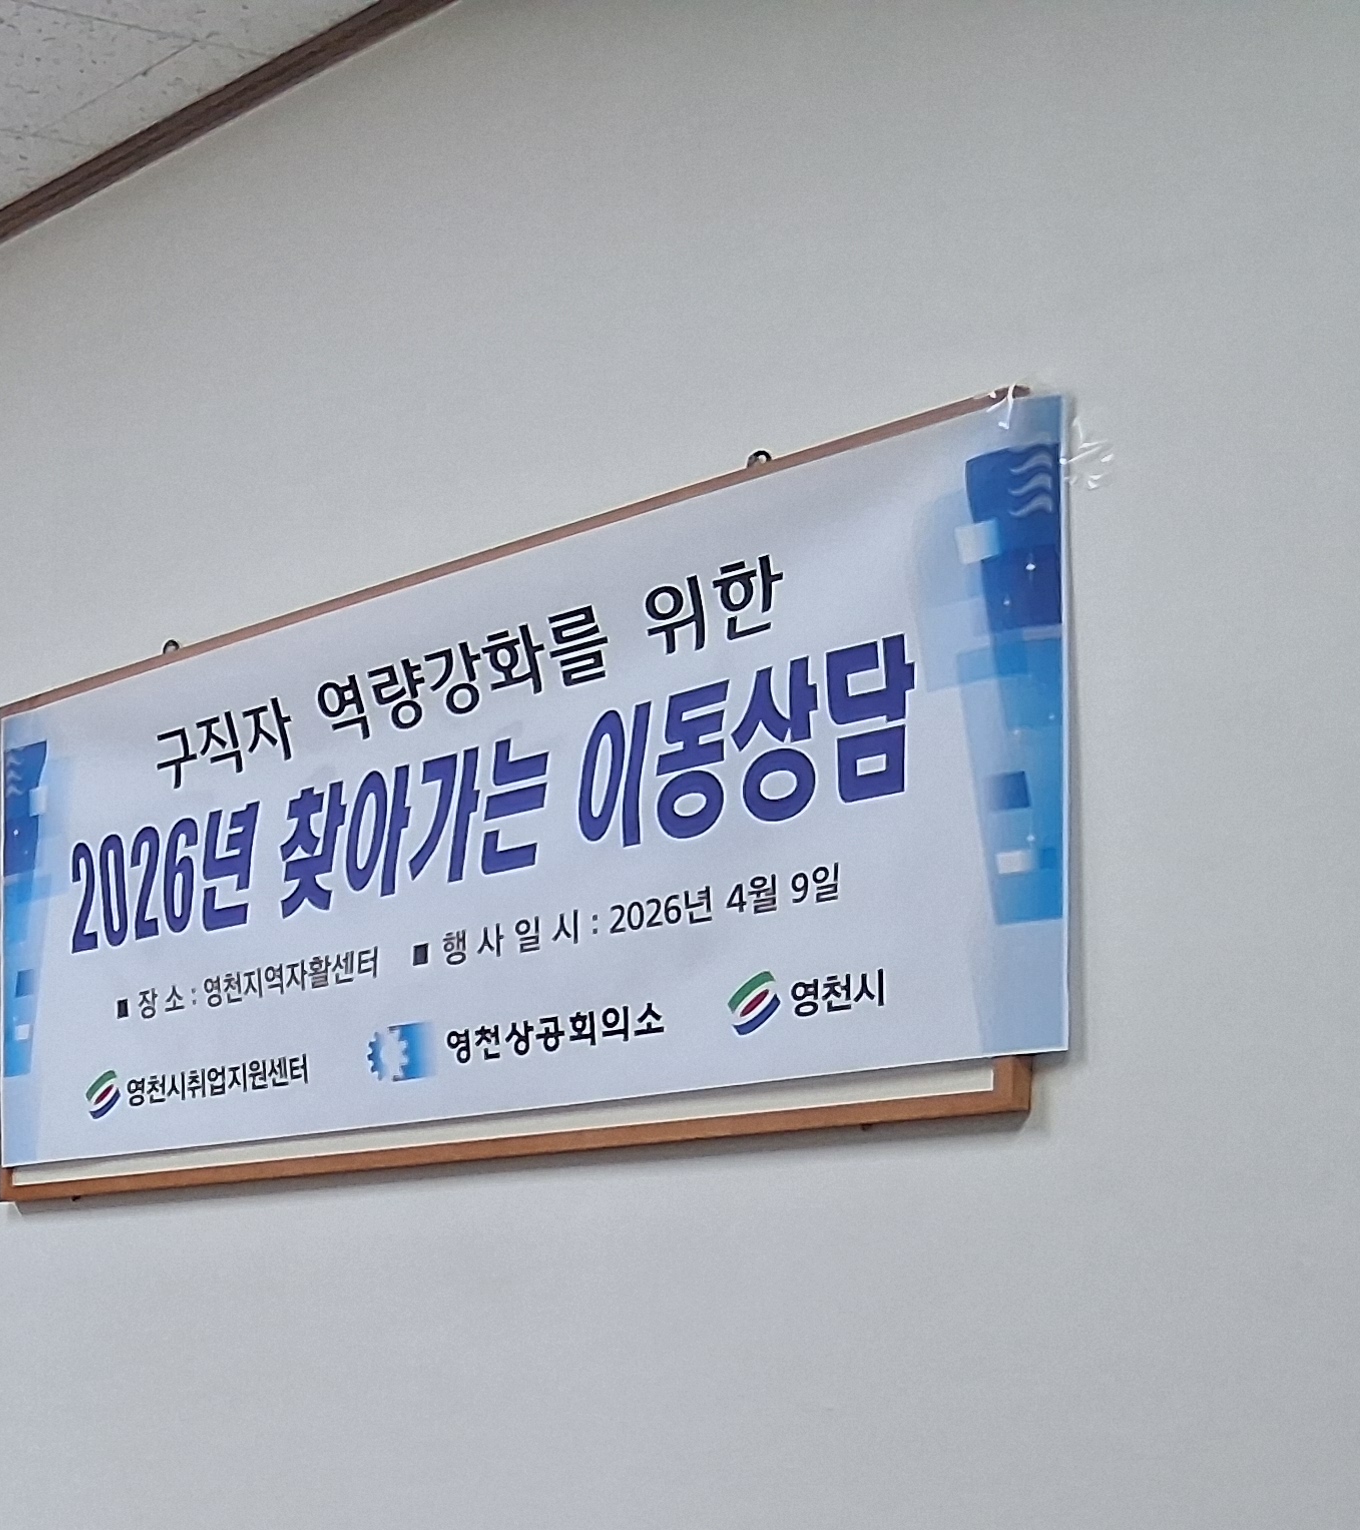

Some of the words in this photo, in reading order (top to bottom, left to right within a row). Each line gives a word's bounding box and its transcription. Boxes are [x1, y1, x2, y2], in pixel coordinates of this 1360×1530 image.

[154, 697, 293, 789] 구직자
[316, 605, 609, 740] 역량강화를
[644, 553, 783, 655] 위한
[70, 801, 261, 954] 2026년
[279, 735, 549, 918] 찾아가는
[577, 632, 916, 851] 이동상담
[609, 885, 713, 935] 2026년
[726, 873, 778, 916] 4월
[791, 862, 841, 904] 9일
[203, 946, 379, 1008] 영천지역자활센터
[790, 968, 886, 1018] 영천시
[446, 1002, 665, 1065] 영천상공회의소
[126, 1053, 309, 1108] 영천시취업지원센터
